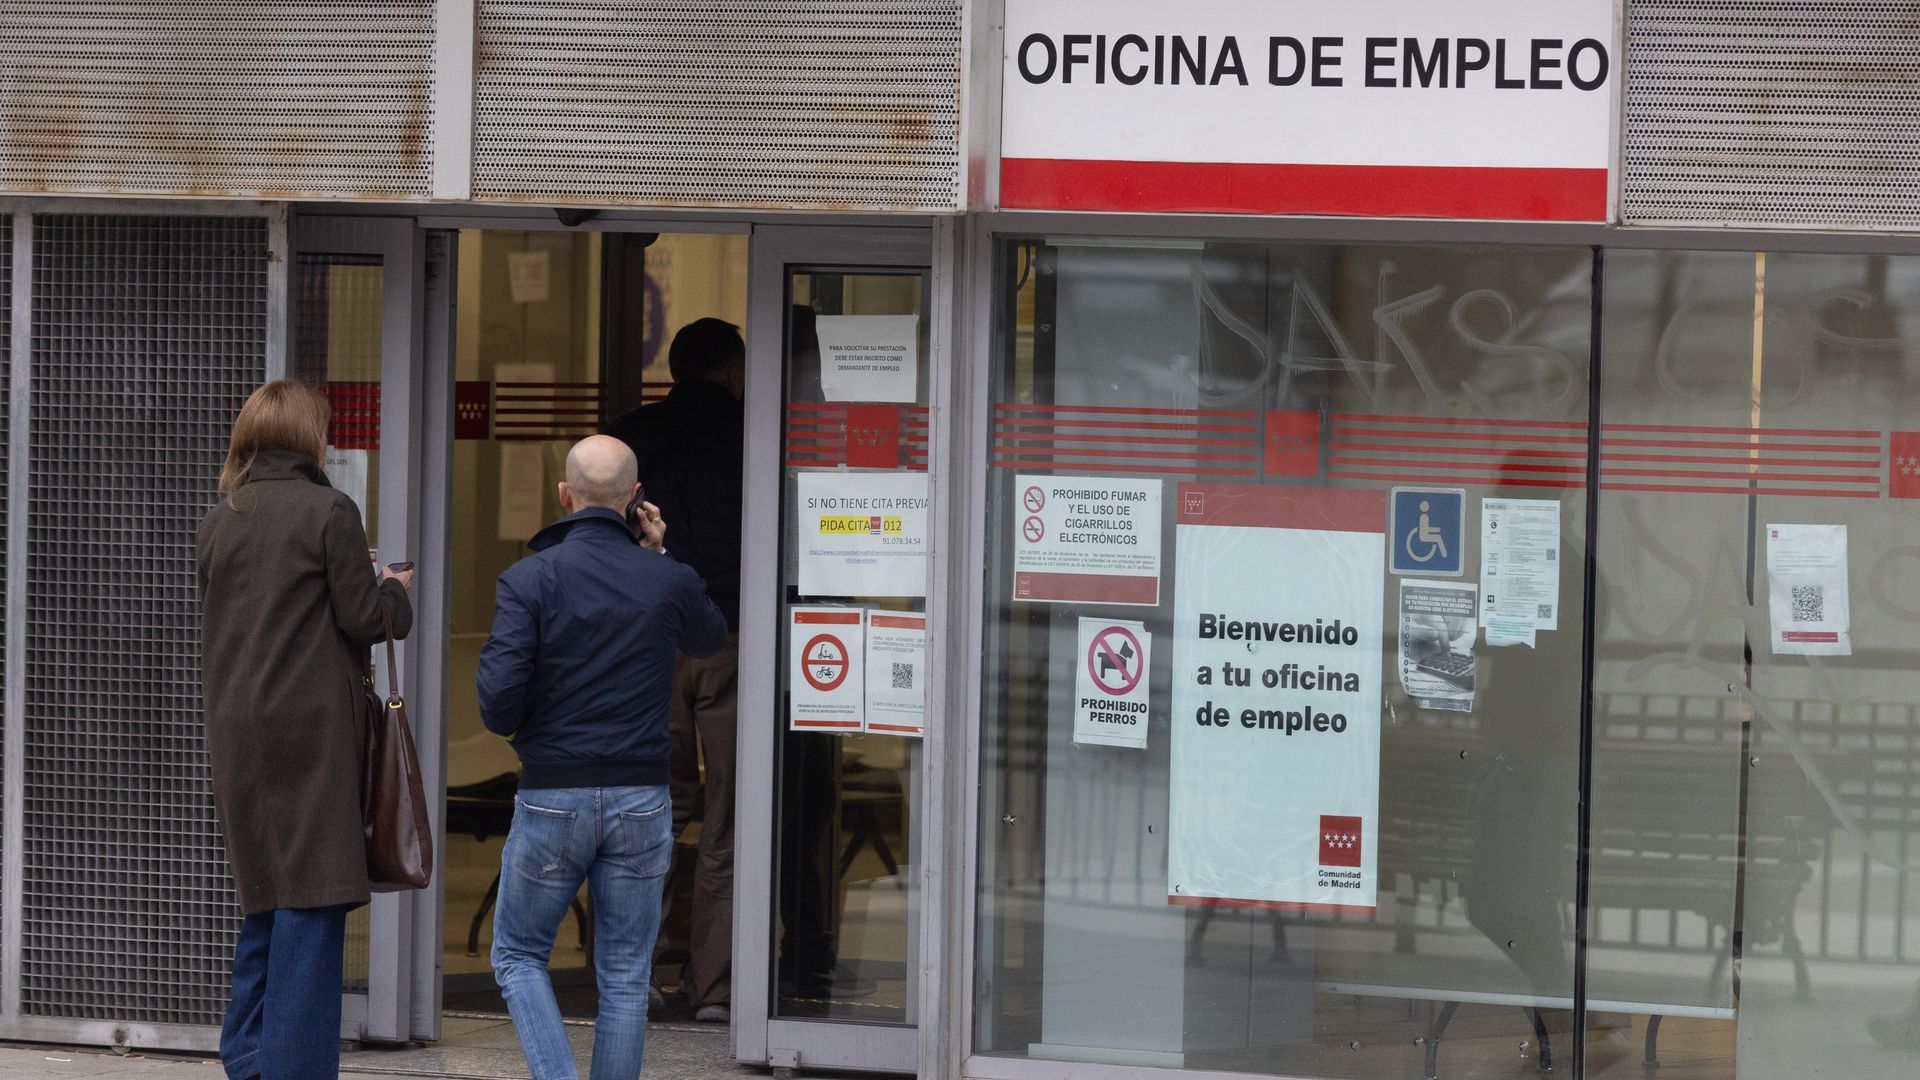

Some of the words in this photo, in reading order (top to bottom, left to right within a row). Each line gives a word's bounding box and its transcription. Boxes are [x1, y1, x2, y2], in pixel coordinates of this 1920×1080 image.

[1016, 32, 1248, 86] OFICINA
[1267, 35, 1343, 88] DE
[1363, 36, 1609, 92] EMPLEO
[1052, 488, 1108, 501] PROHIBIDO
[1111, 490, 1147, 502] FUMAR
[807, 497, 817, 509] SI
[820, 498, 837, 509] NO
[839, 498, 869, 509] TIENE
[871, 498, 893, 509] CITA
[1068, 503, 1075, 514] Y
[1077, 504, 1090, 515] EL
[1092, 505, 1114, 516] USO
[1116, 505, 1130, 516] DE
[820, 519, 845, 531] PIDA
[847, 519, 871, 531] CITA
[883, 520, 902, 531] 012
[1064, 518, 1132, 531] CIGARRILLOS
[882, 537, 921, 545] 91.078.34.54
[1059, 532, 1137, 545] ELECTRÓNICOS
[1198, 613, 1359, 646] Bienvenido
[1196, 665, 1212, 685] a
[1222, 662, 1251, 687] tu
[1261, 663, 1360, 693] oficina
[1080, 698, 1147, 714] PROHIBIDO
[1089, 711, 1137, 726] PERROS
[1196, 701, 1230, 727] de
[1240, 706, 1347, 736] empleo
[1318, 869, 1361, 879] Comunidad
[1318, 879, 1329, 887] de
[1331, 880, 1361, 889] Madrid
